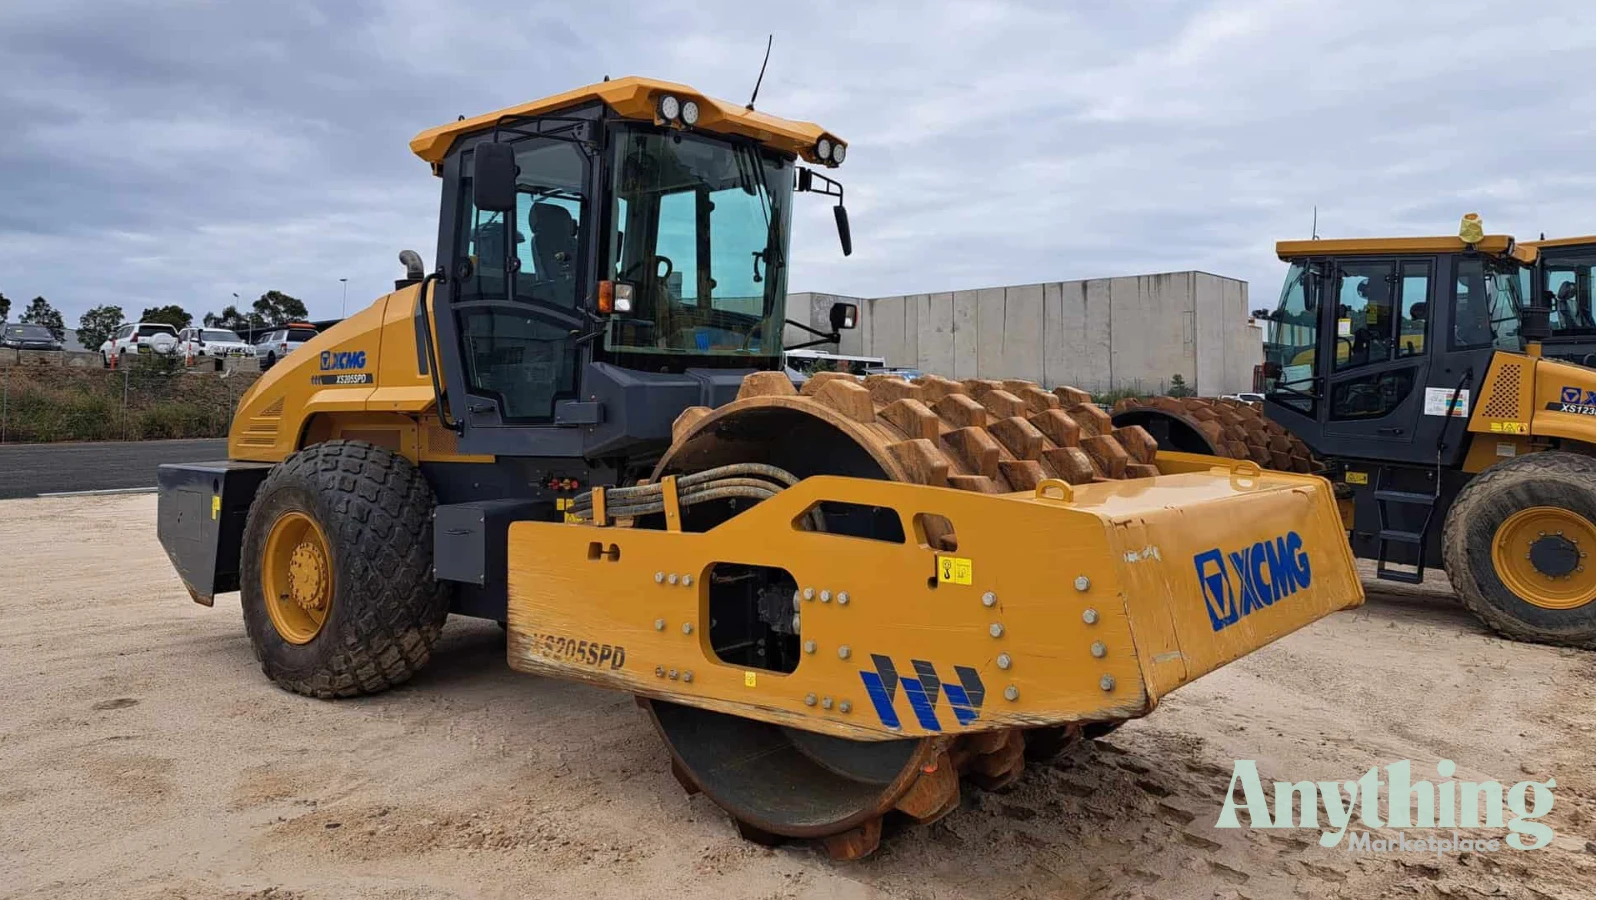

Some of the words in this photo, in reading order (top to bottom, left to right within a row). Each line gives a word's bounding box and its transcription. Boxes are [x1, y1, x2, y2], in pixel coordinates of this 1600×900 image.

[331, 350, 367, 370] XCMG
[1560, 403, 1596, 416] XS123
[1227, 531, 1312, 618] XCMG
